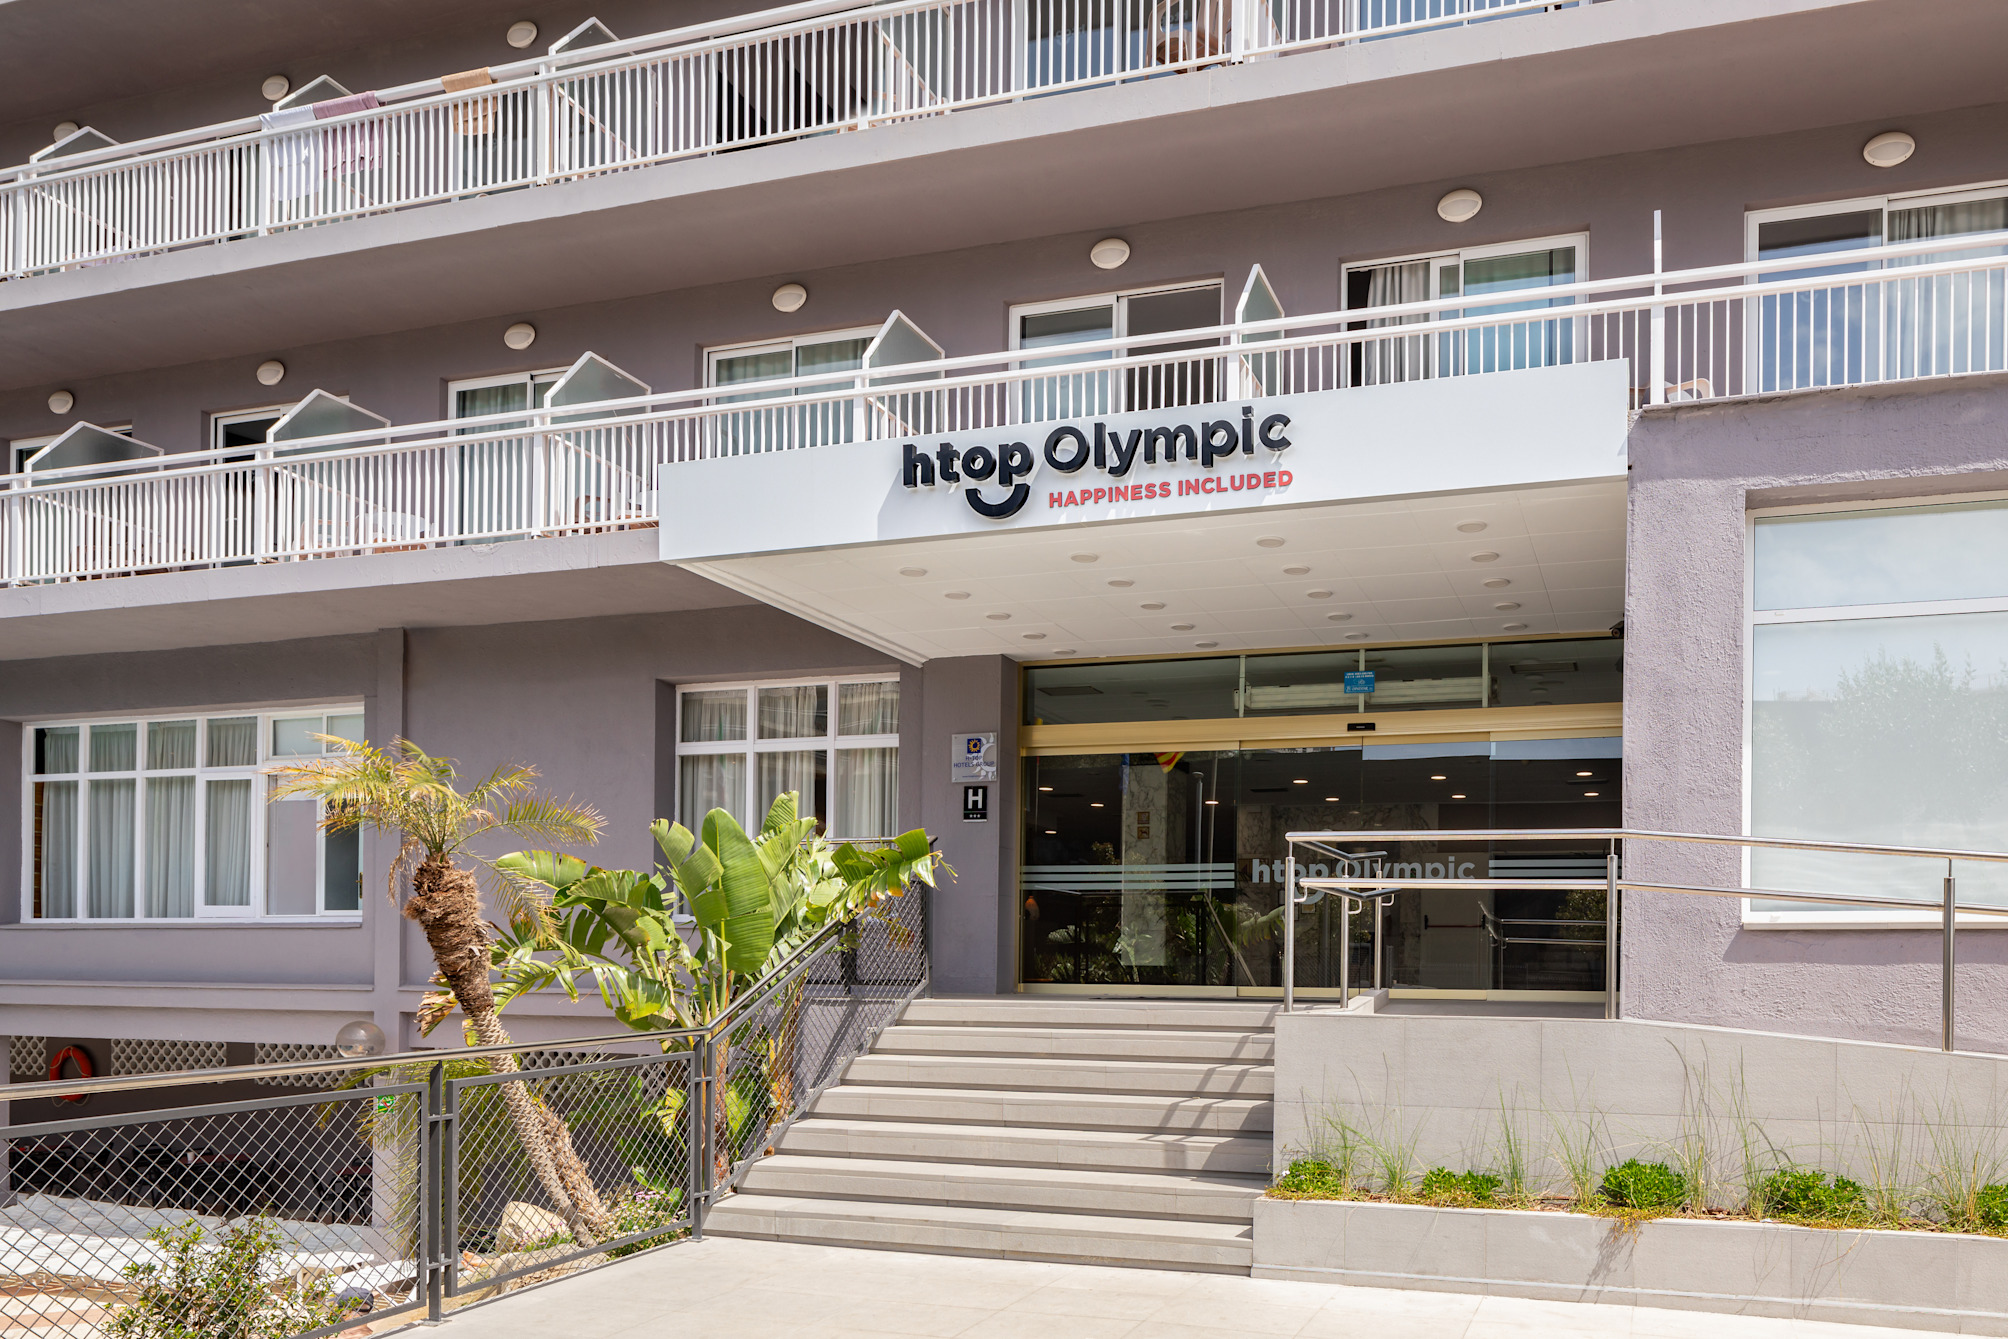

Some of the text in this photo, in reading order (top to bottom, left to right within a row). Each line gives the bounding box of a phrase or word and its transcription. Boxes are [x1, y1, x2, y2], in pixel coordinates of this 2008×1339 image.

[902, 405, 1292, 488] htop Olympic
[1049, 470, 1293, 508] HAPPINESS INCLUDED
[968, 788, 983, 809] H
